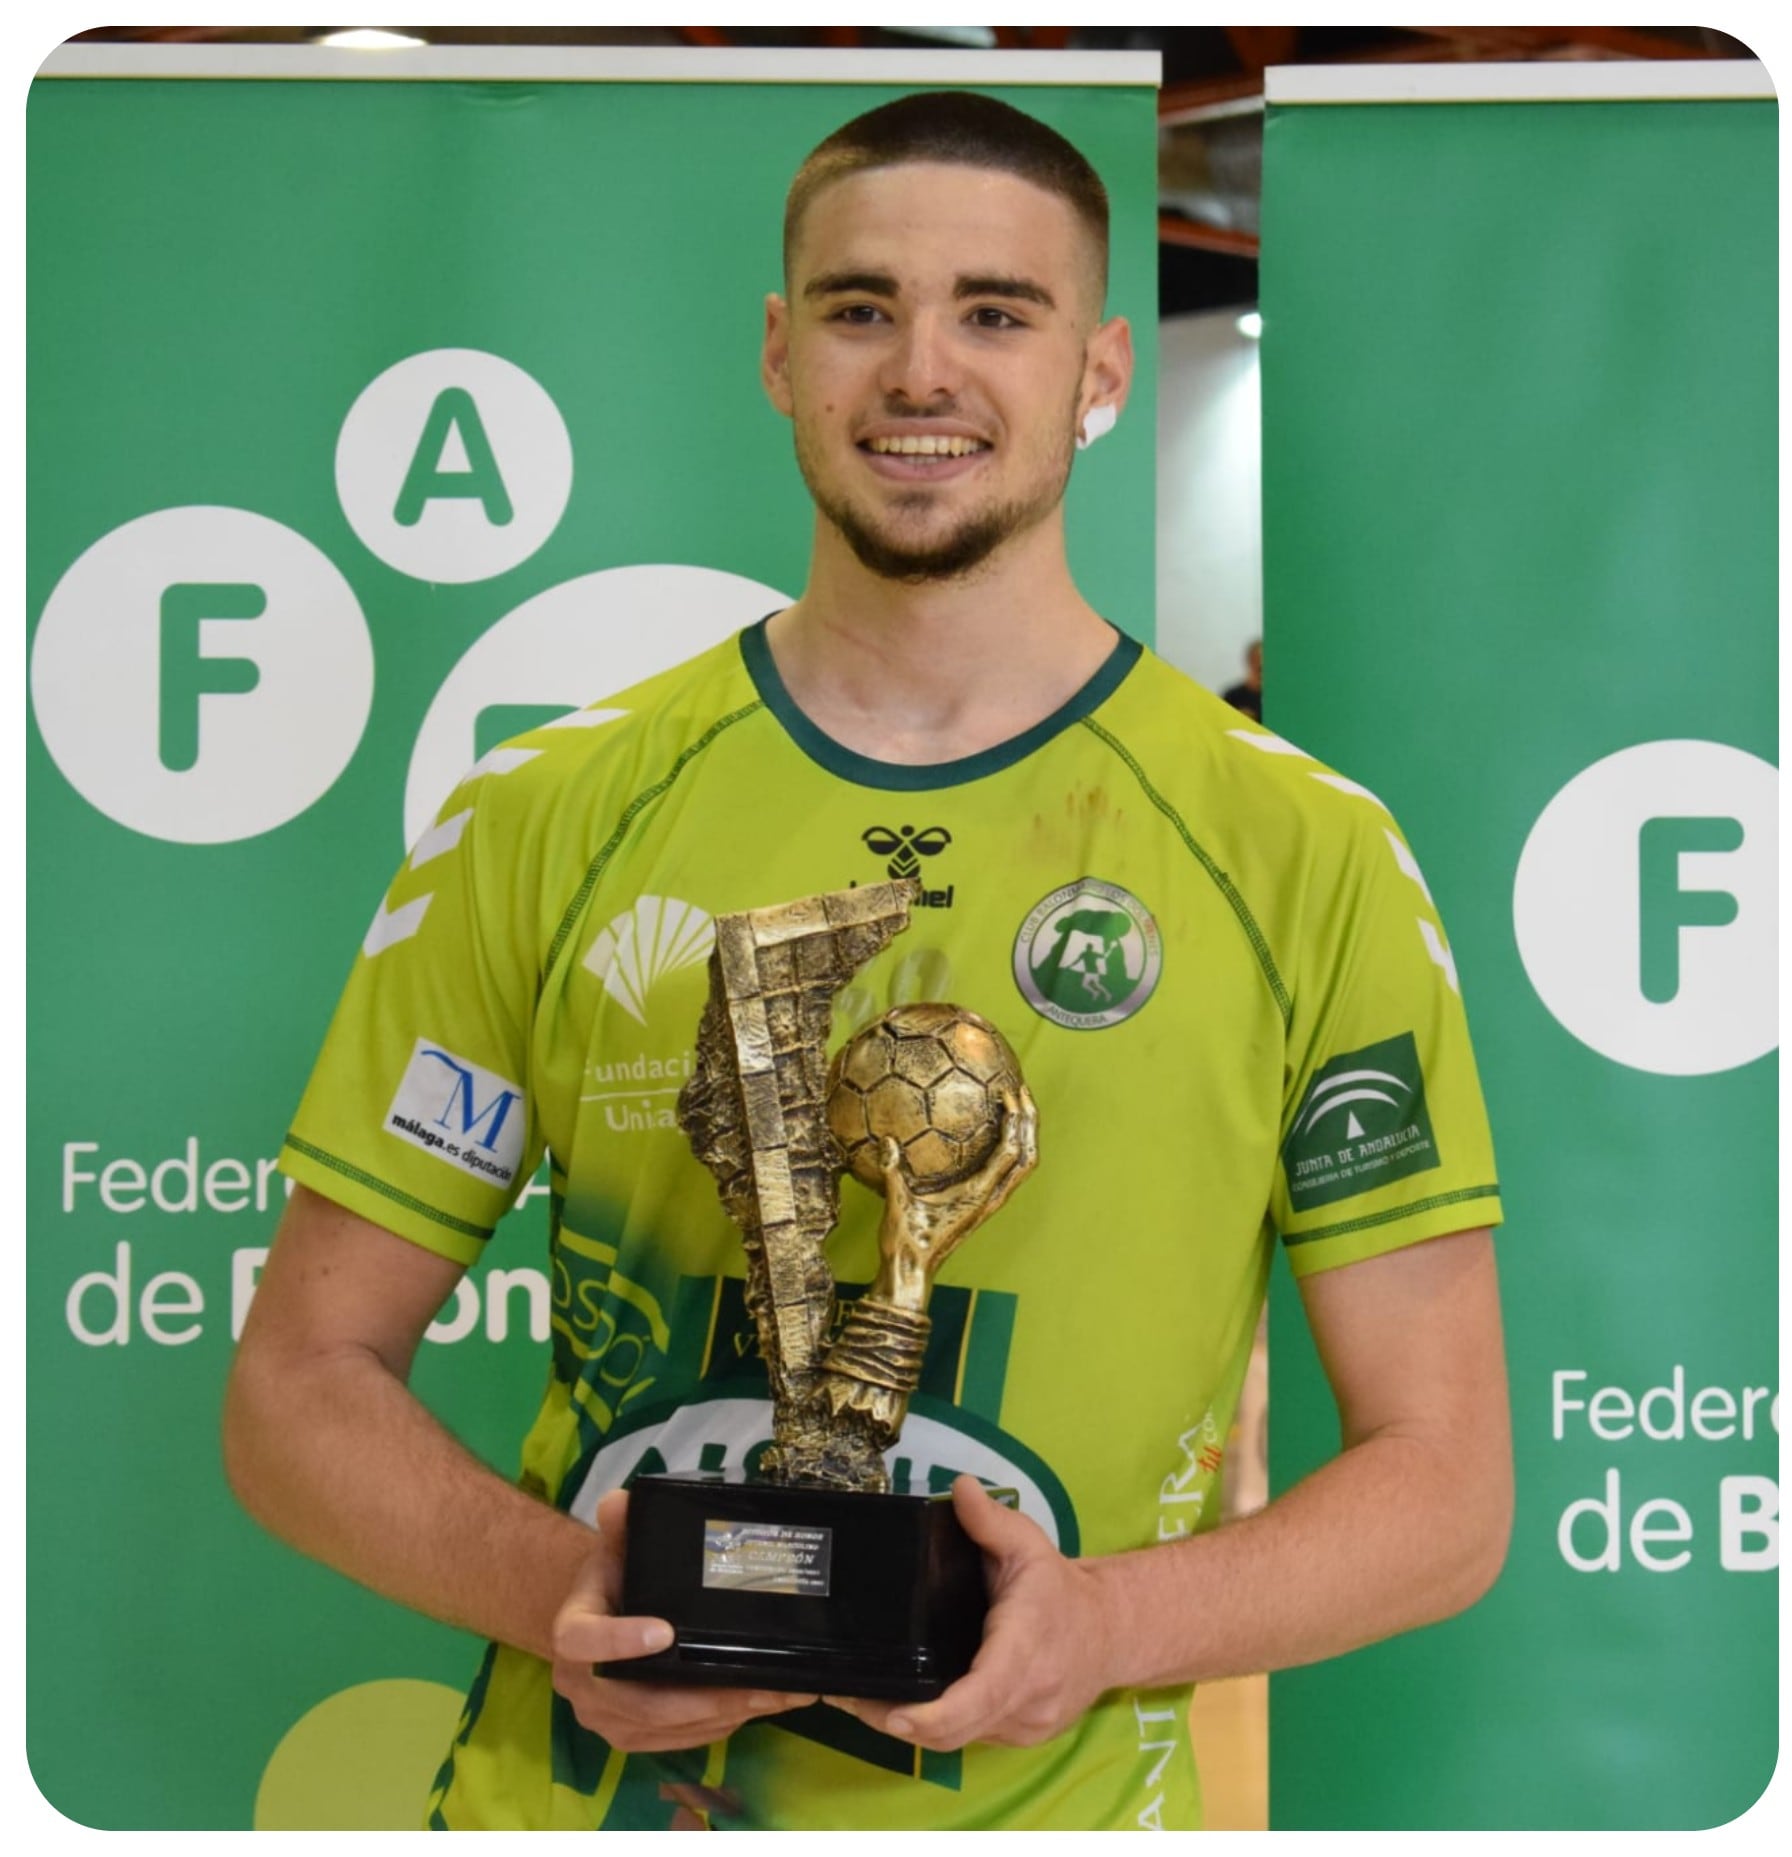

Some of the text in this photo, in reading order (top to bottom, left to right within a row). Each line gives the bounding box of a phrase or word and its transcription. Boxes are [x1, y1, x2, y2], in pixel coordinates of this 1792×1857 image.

[393, 386, 514, 528] A
[157, 582, 268, 773] F
[1638, 815, 1745, 1005] F
[1048, 1003, 1108, 1028] ANTEQUERA
[420, 1049, 522, 1154] M
[1296, 1154, 1334, 1177] JUNTA
[1337, 1148, 1355, 1164] DE
[65, 1240, 205, 1346] de
[1556, 1467, 1694, 1573] de
